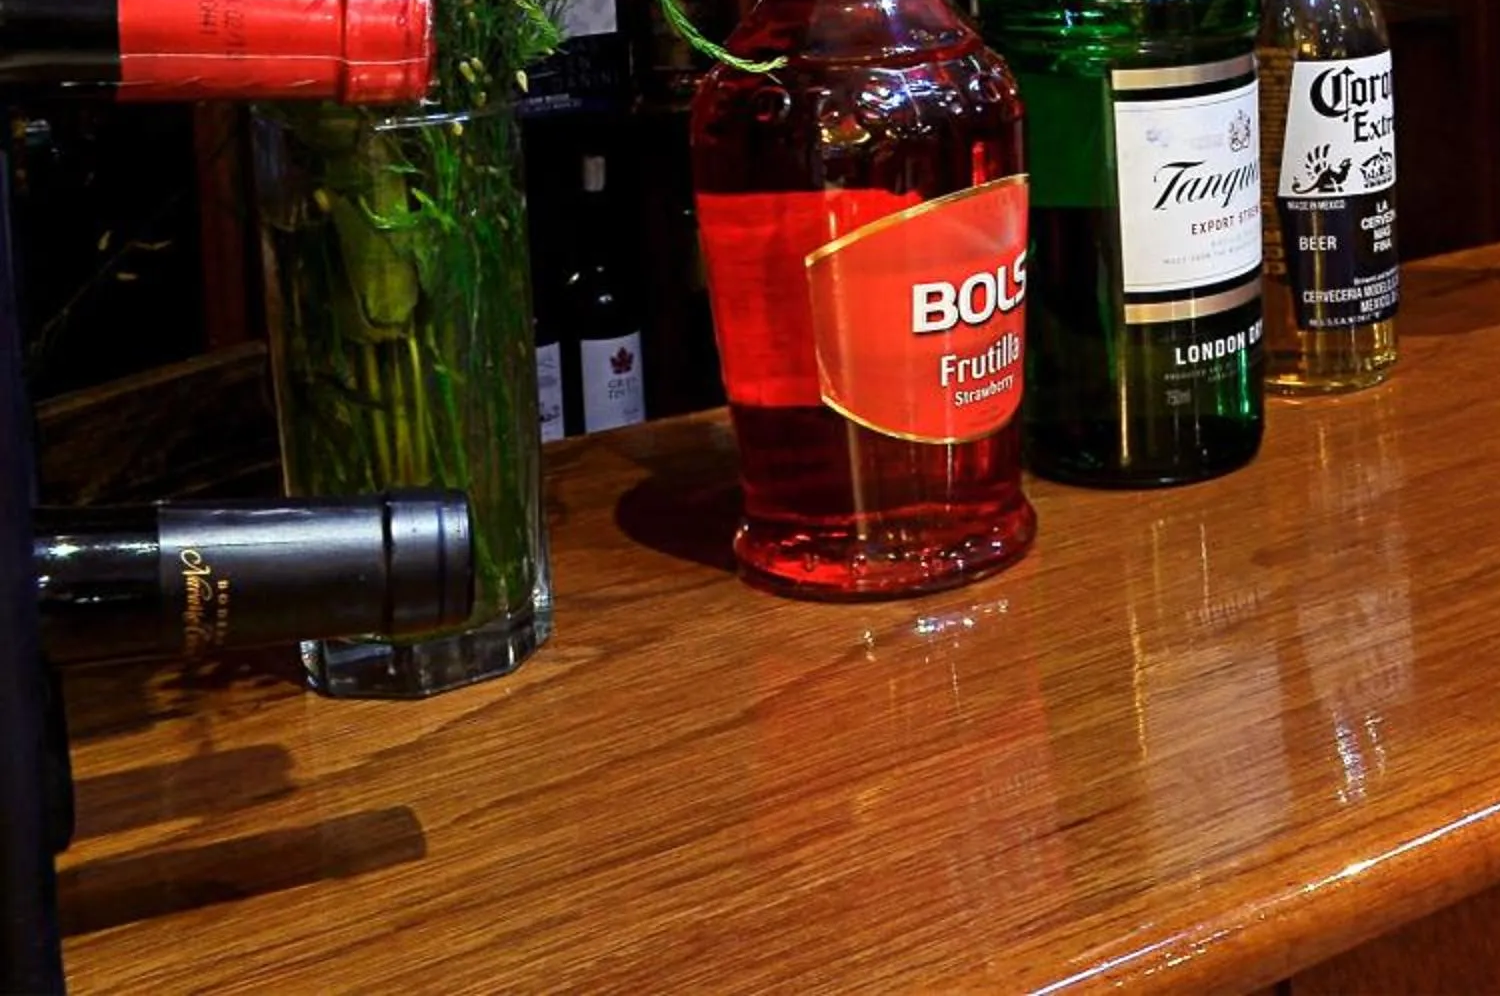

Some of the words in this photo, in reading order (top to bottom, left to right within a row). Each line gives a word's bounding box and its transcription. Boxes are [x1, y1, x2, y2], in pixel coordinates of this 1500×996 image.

[1191, 215, 1236, 236] EXPORT
[1298, 235, 1338, 251] BEER
[911, 249, 1028, 335] BOLS
[940, 332, 1021, 388] Frutilla
[1174, 331, 1247, 365] LONDON
[954, 373, 1016, 407] Strawberry
